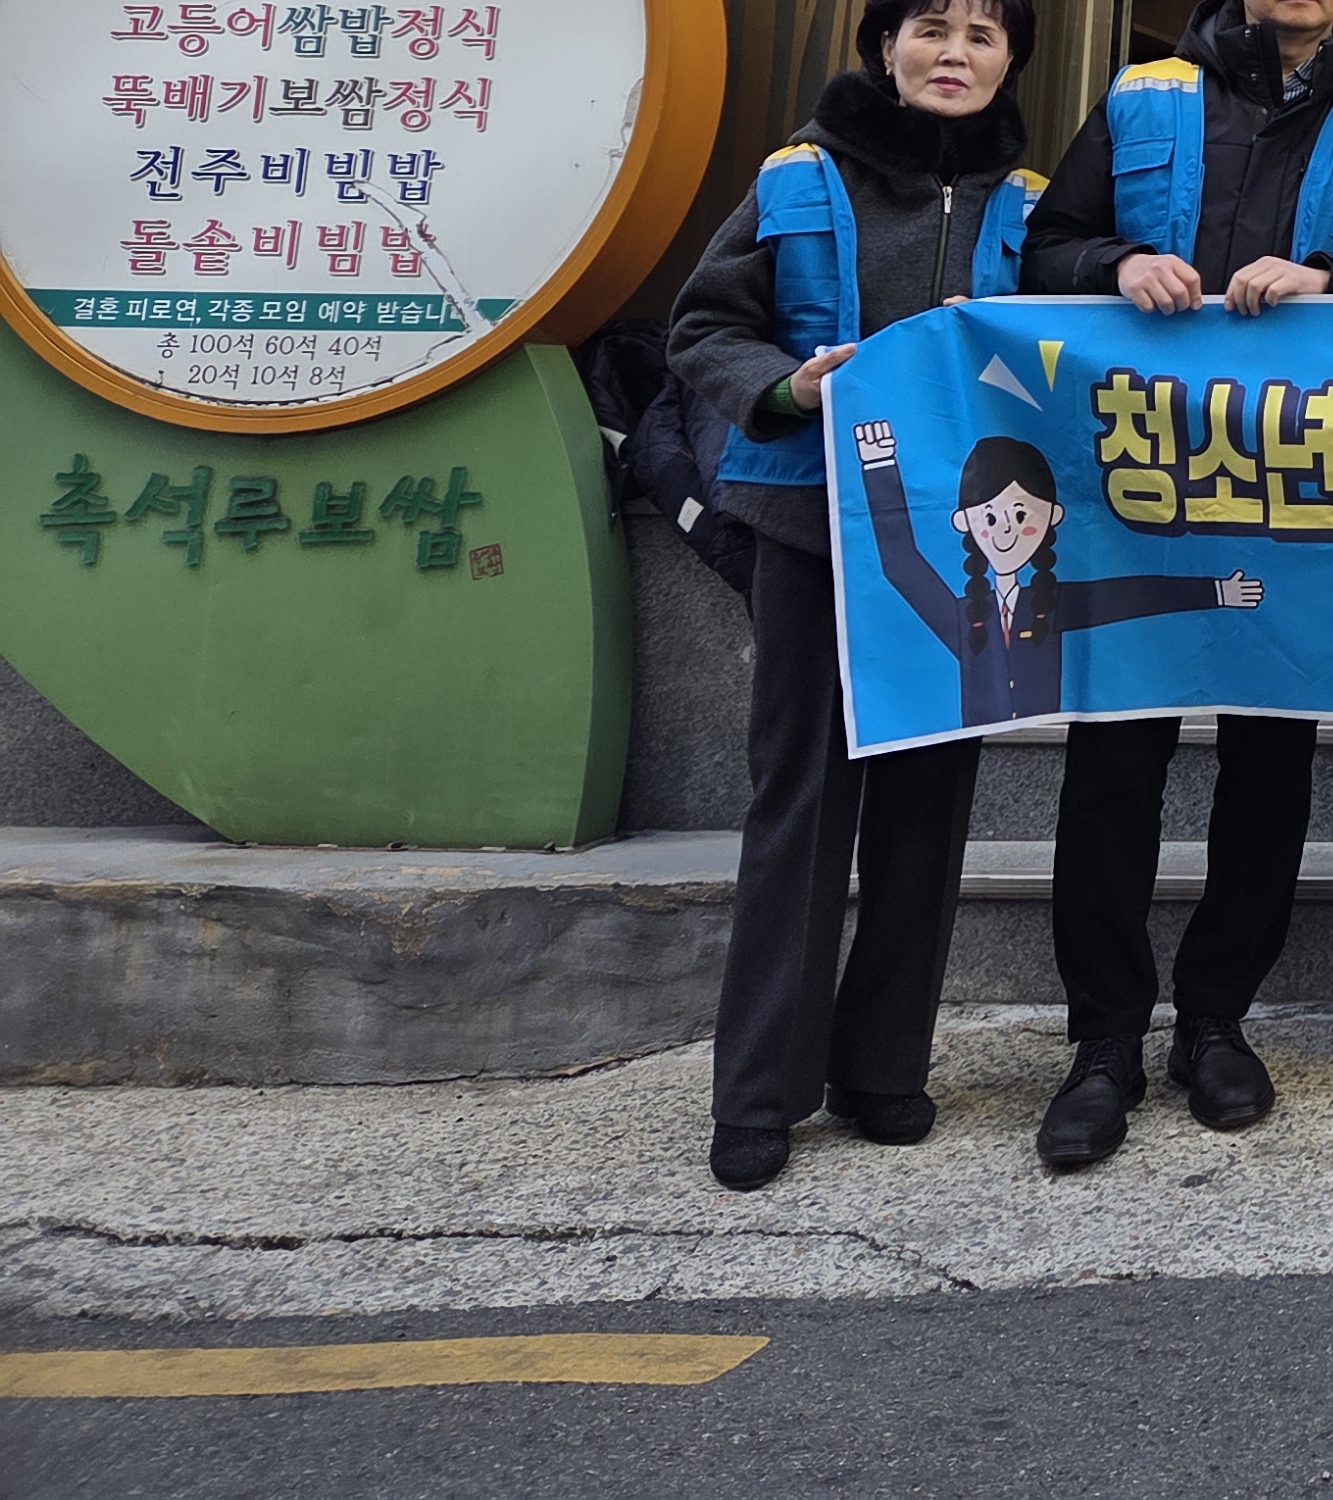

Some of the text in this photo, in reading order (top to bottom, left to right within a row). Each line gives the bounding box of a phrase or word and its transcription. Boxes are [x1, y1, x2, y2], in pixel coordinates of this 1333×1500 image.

[109, 2, 500, 61] 고등어쌈밥정식
[101, 73, 494, 133] 뚝배기보쌈정식
[129, 146, 445, 204] 전주비빔밥
[119, 218, 428, 279] 돌솥비빔밥
[73, 297, 120, 321] 결혼
[125, 298, 202, 325] 피로연,
[207, 299, 255, 323] 각종
[258, 300, 306, 323] 모임
[317, 301, 366, 324] 예약
[156, 332, 382, 359] 총 100석 60석 40석
[187, 363, 347, 391] 20석 10석 8석
[38, 453, 482, 572] 촉석루보쌈
